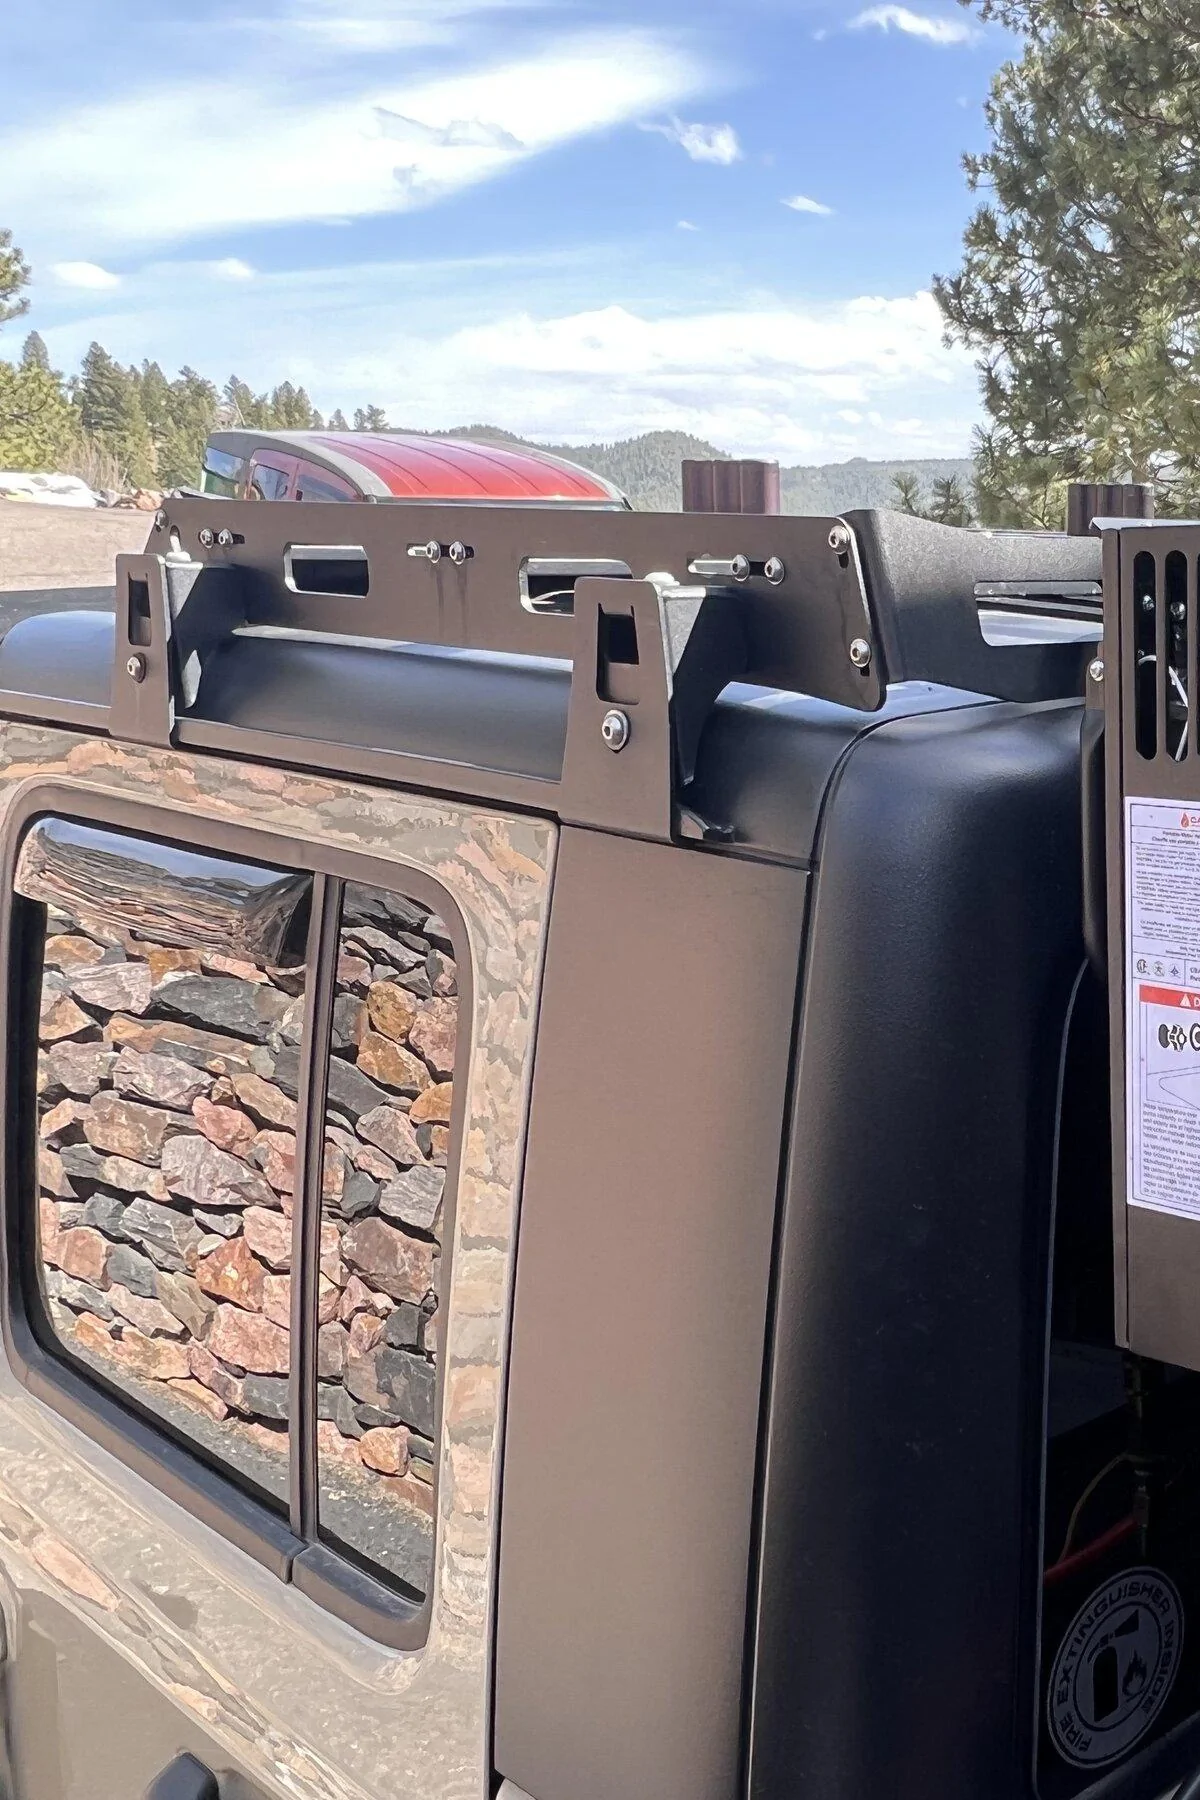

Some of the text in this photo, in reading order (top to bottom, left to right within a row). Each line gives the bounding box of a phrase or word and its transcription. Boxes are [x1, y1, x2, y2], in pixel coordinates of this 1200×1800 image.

[1057, 1581, 1174, 1752] FIRE EXTINGUISHER INSIDE
